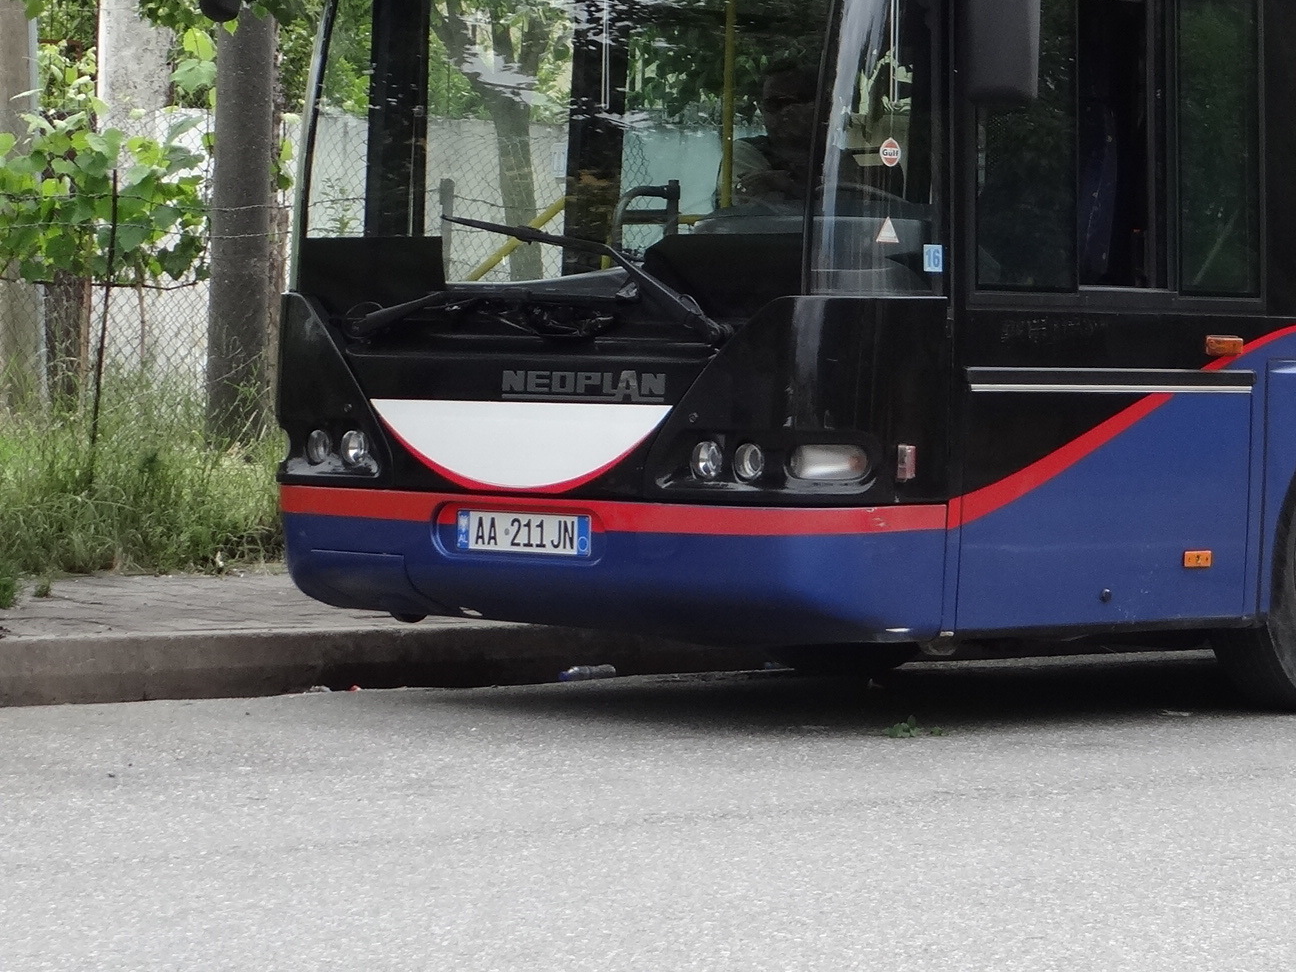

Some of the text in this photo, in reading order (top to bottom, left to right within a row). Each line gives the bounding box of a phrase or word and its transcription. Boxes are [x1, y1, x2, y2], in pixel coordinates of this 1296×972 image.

[882, 148, 899, 157] Gulf
[925, 249, 940, 268] 16
[502, 370, 666, 402] NEOPLAN
[475, 516, 575, 549] AA 211 JN
